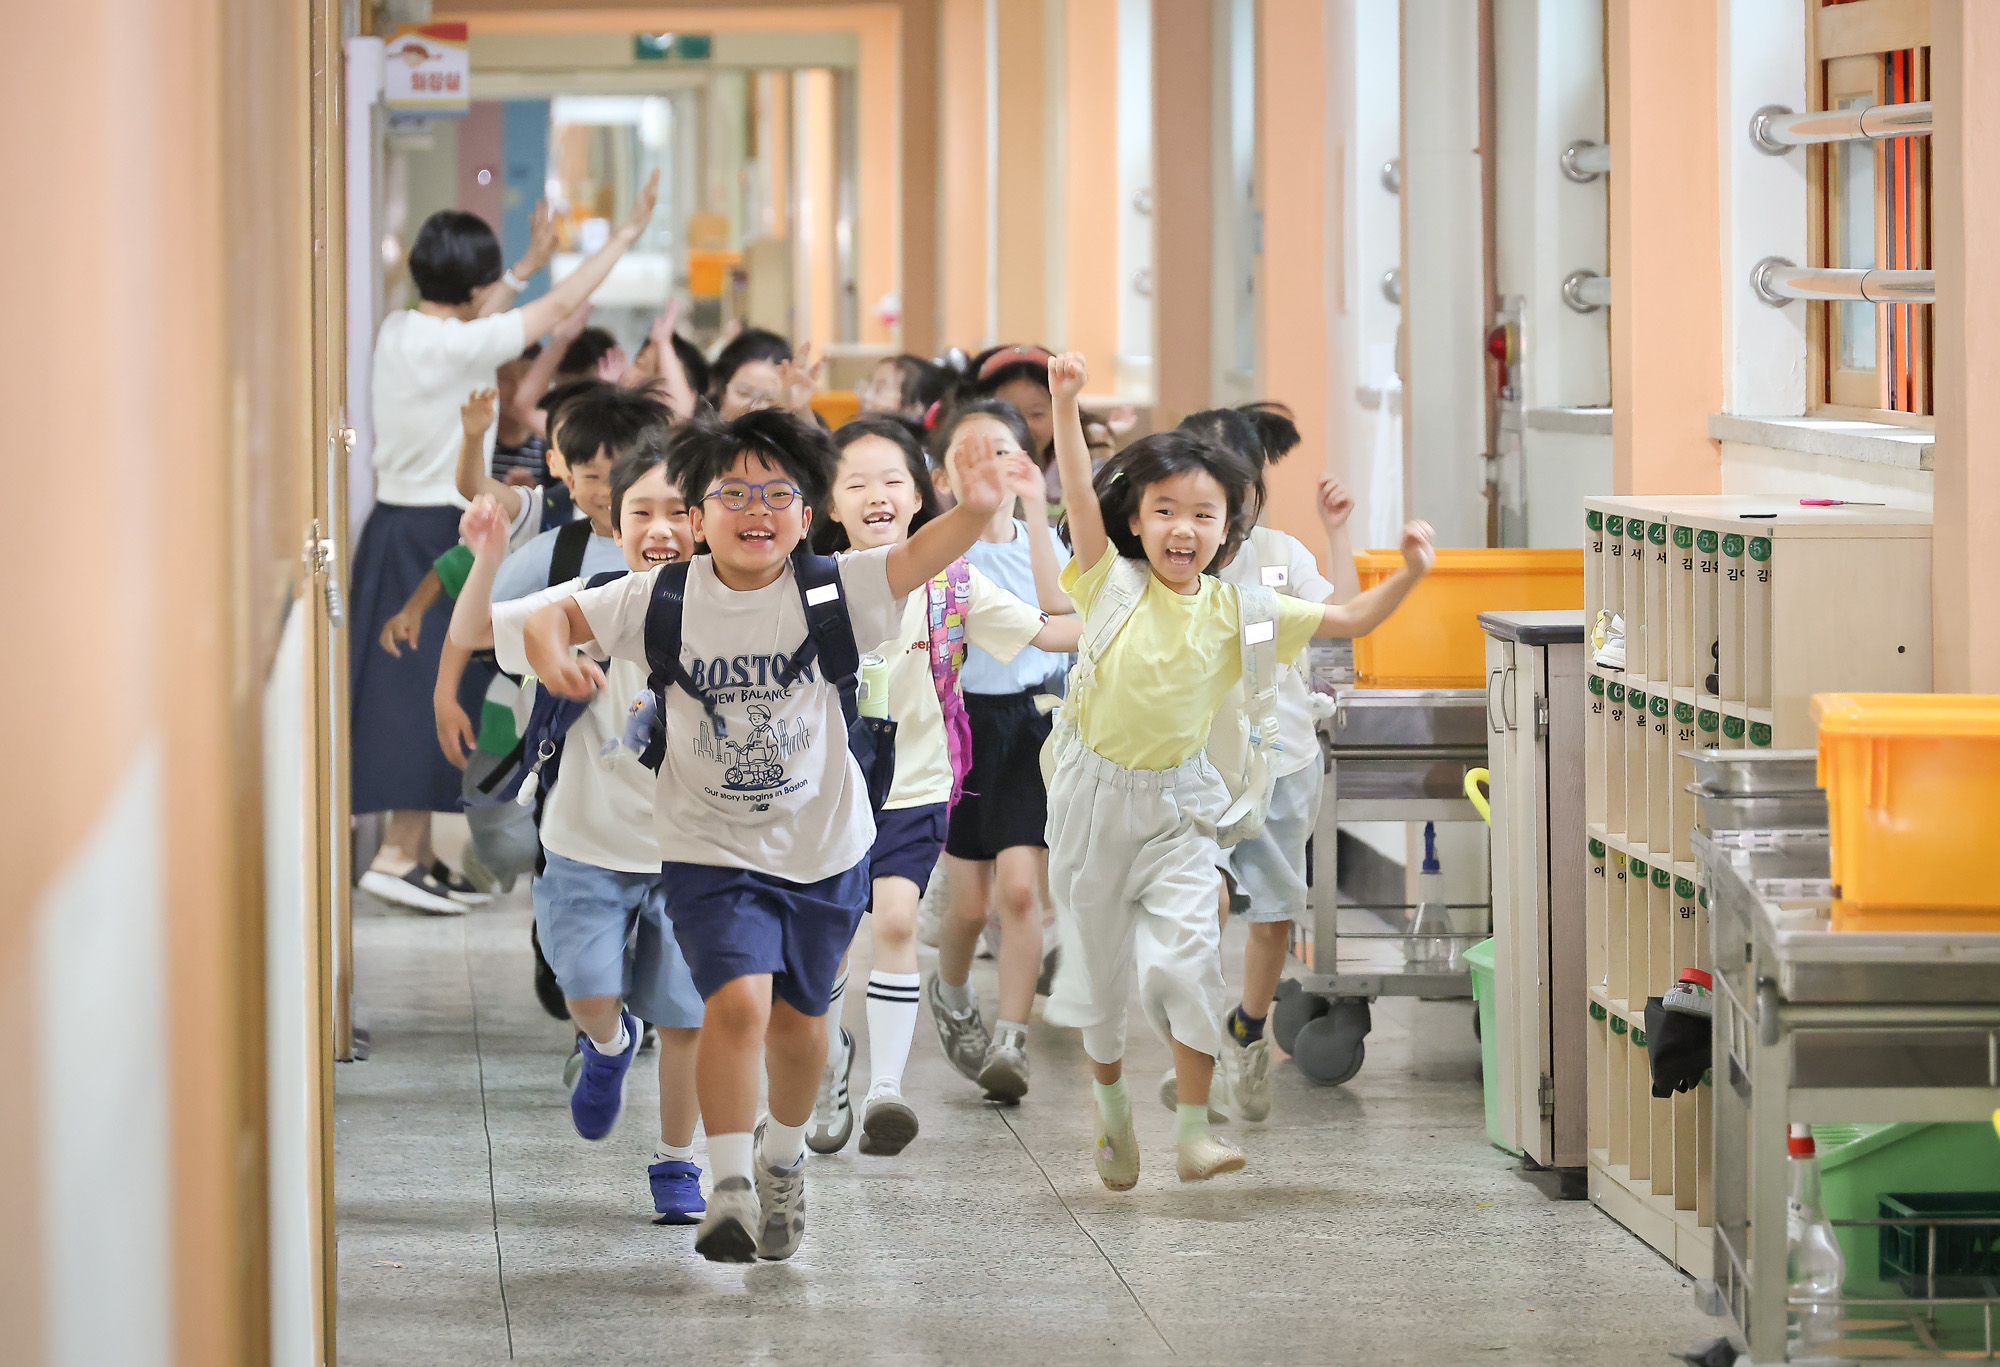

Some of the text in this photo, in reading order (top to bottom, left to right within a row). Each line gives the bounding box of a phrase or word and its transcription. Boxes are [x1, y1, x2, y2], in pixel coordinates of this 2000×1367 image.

[1613, 518, 1622, 531] 2
[1634, 522, 1643, 536] 3
[1654, 526, 1664, 540] 4
[1678, 530, 1692, 544] 51
[1593, 541, 1603, 552] 김
[1701, 534, 1717, 549] 52
[1727, 538, 1743, 552] 53
[1611, 544, 1621, 556] 김
[1753, 541, 1770, 557] 54
[1682, 558, 1692, 570] 김
[1757, 569, 1772, 582] 김
[906, 640, 930, 654] eep
[710, 689, 791, 704] NEW BALANCE
[1614, 684, 1623, 698] 6
[1635, 691, 1644, 704] 7
[1592, 703, 1604, 713] 신
[1656, 698, 1666, 713] 8
[1680, 705, 1694, 719] 55
[1703, 713, 1718, 727] 56
[1728, 720, 1742, 734] 57
[1655, 724, 1668, 735] 이
[1754, 726, 1770, 741] 58
[705, 786, 718, 796] Our
[720, 793, 740, 801] story
[743, 793, 773, 802] begins
[784, 779, 808, 794] Boston
[1596, 841, 1604, 853] 9
[1594, 866, 1604, 877] 이
[1636, 861, 1647, 873] 11
[1657, 871, 1670, 884] 12
[1680, 880, 1694, 895] 59
